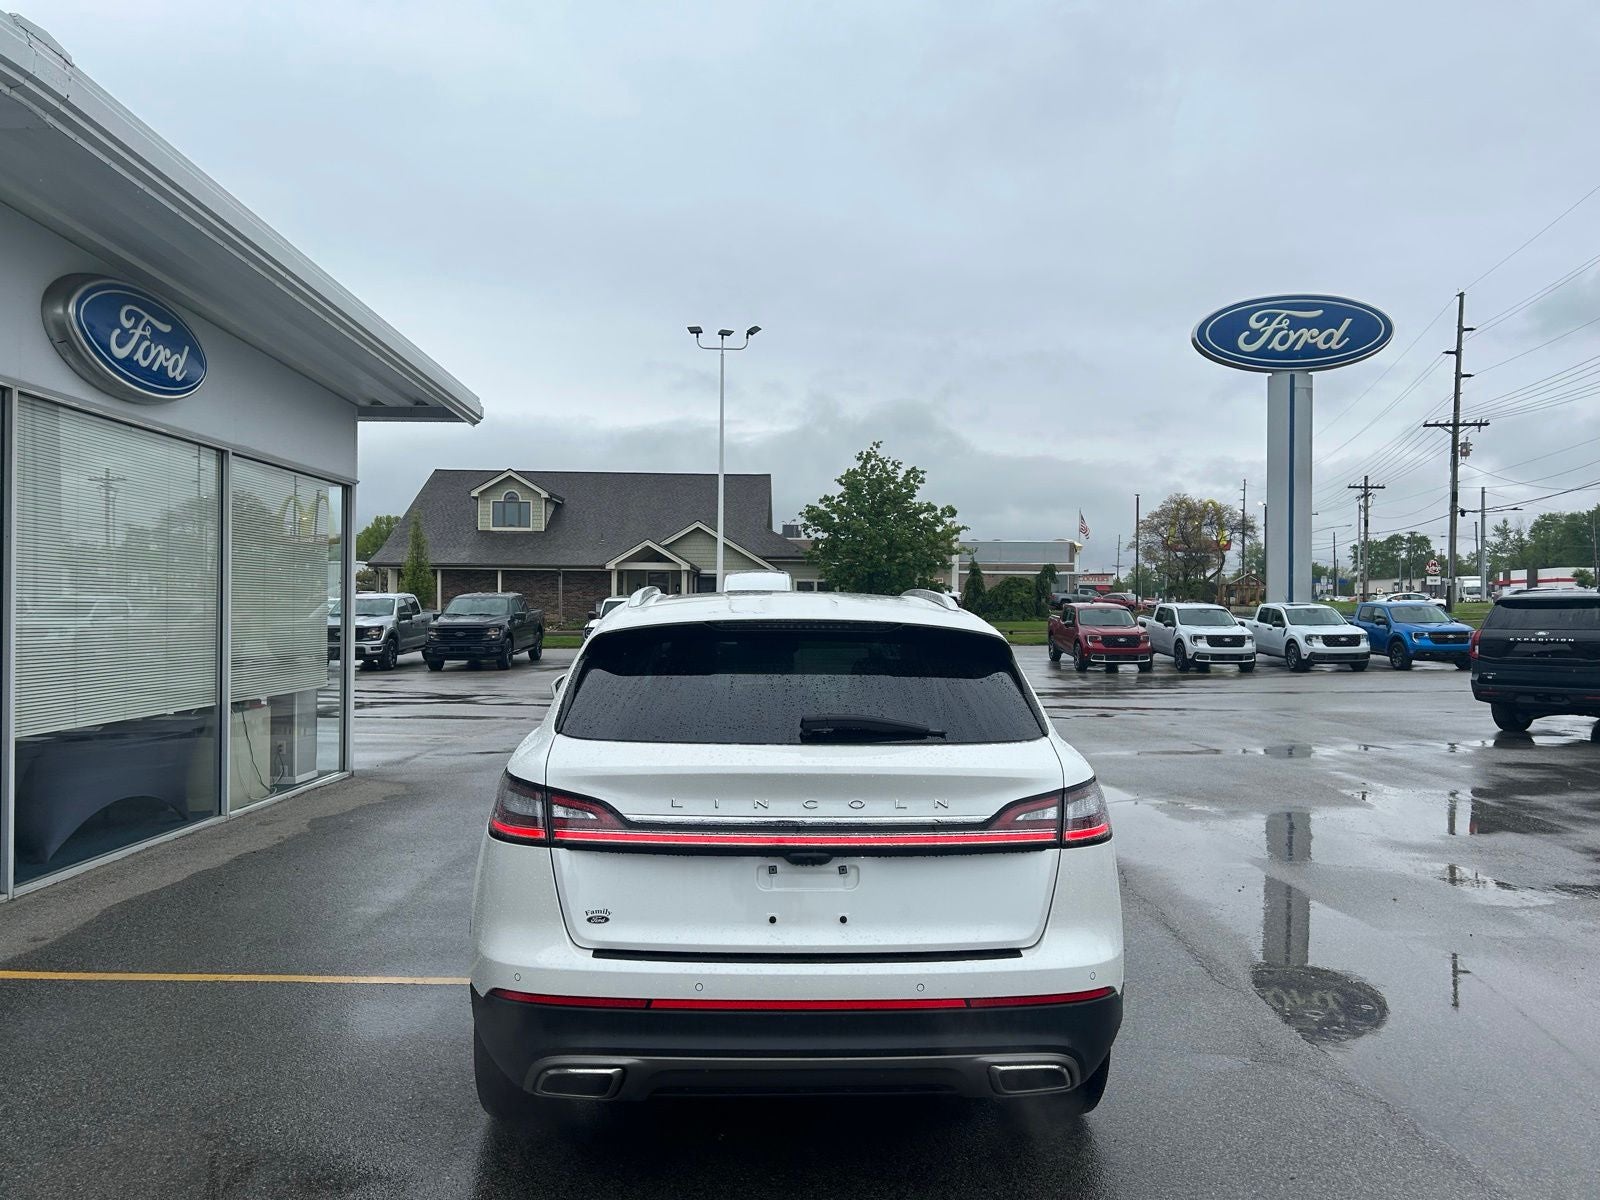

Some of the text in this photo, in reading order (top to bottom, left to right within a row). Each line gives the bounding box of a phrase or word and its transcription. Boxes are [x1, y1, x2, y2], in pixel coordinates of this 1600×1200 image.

[110, 304, 190, 382] Ford
[1238, 309, 1352, 352] Ford
[671, 798, 949, 809] LINCOLN
[585, 908, 612, 916] Family
